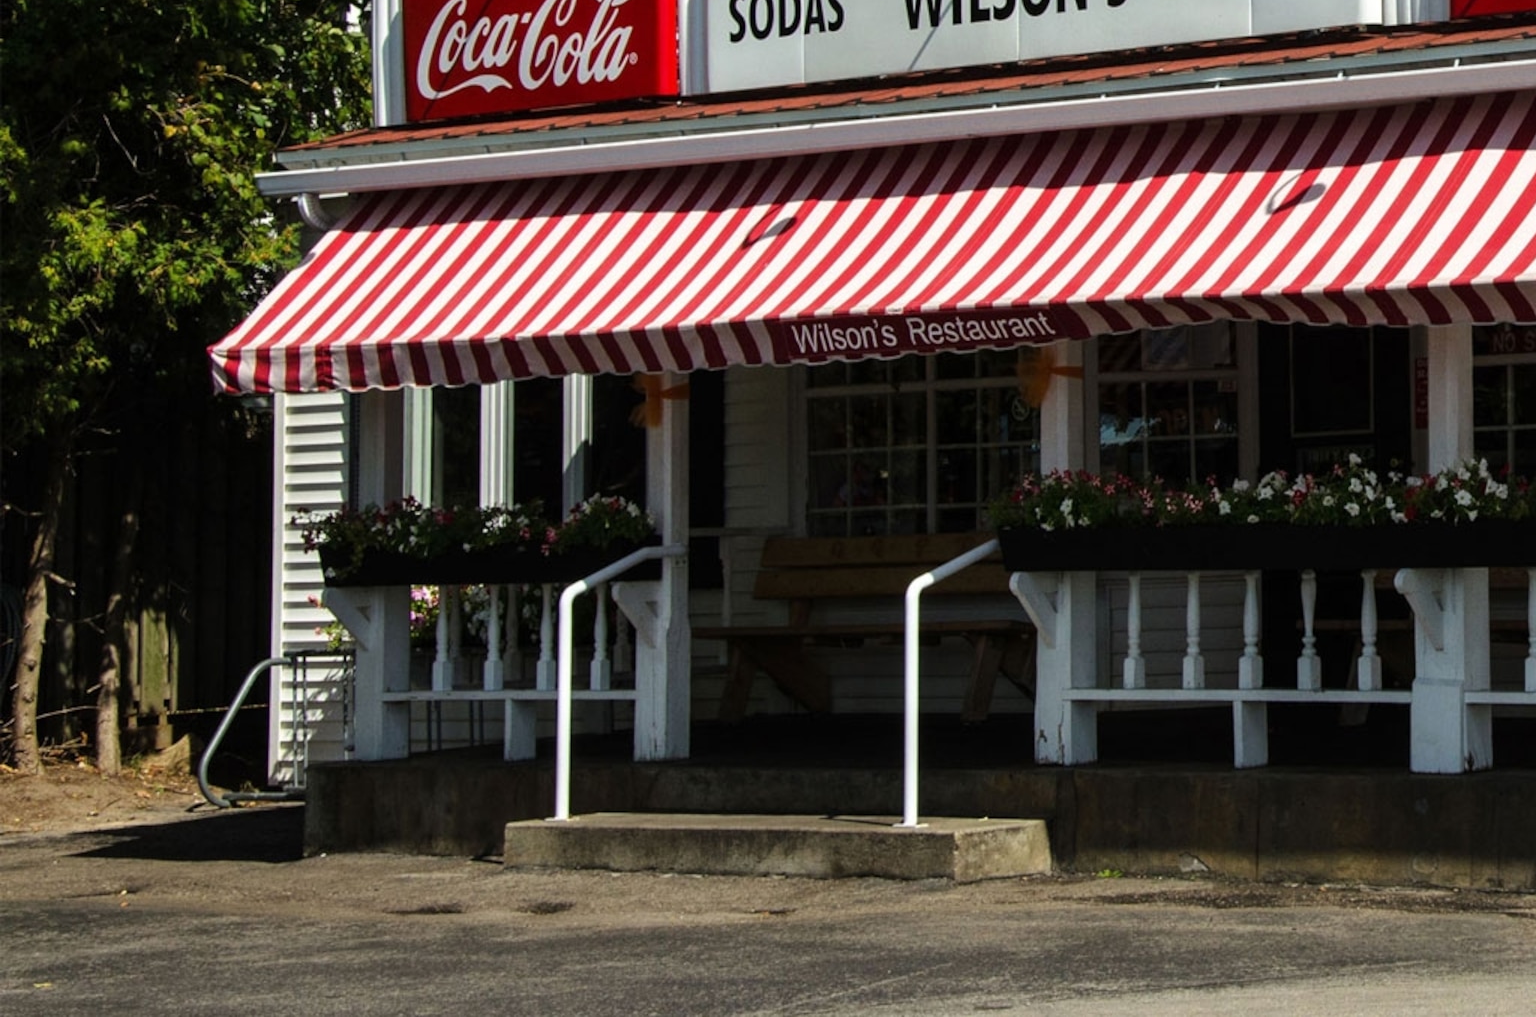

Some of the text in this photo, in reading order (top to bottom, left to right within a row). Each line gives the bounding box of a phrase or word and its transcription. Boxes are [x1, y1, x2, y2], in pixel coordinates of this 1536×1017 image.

[790, 312, 1057, 353] Wilson's Restaurant
[1491, 332, 1517, 352] NO
